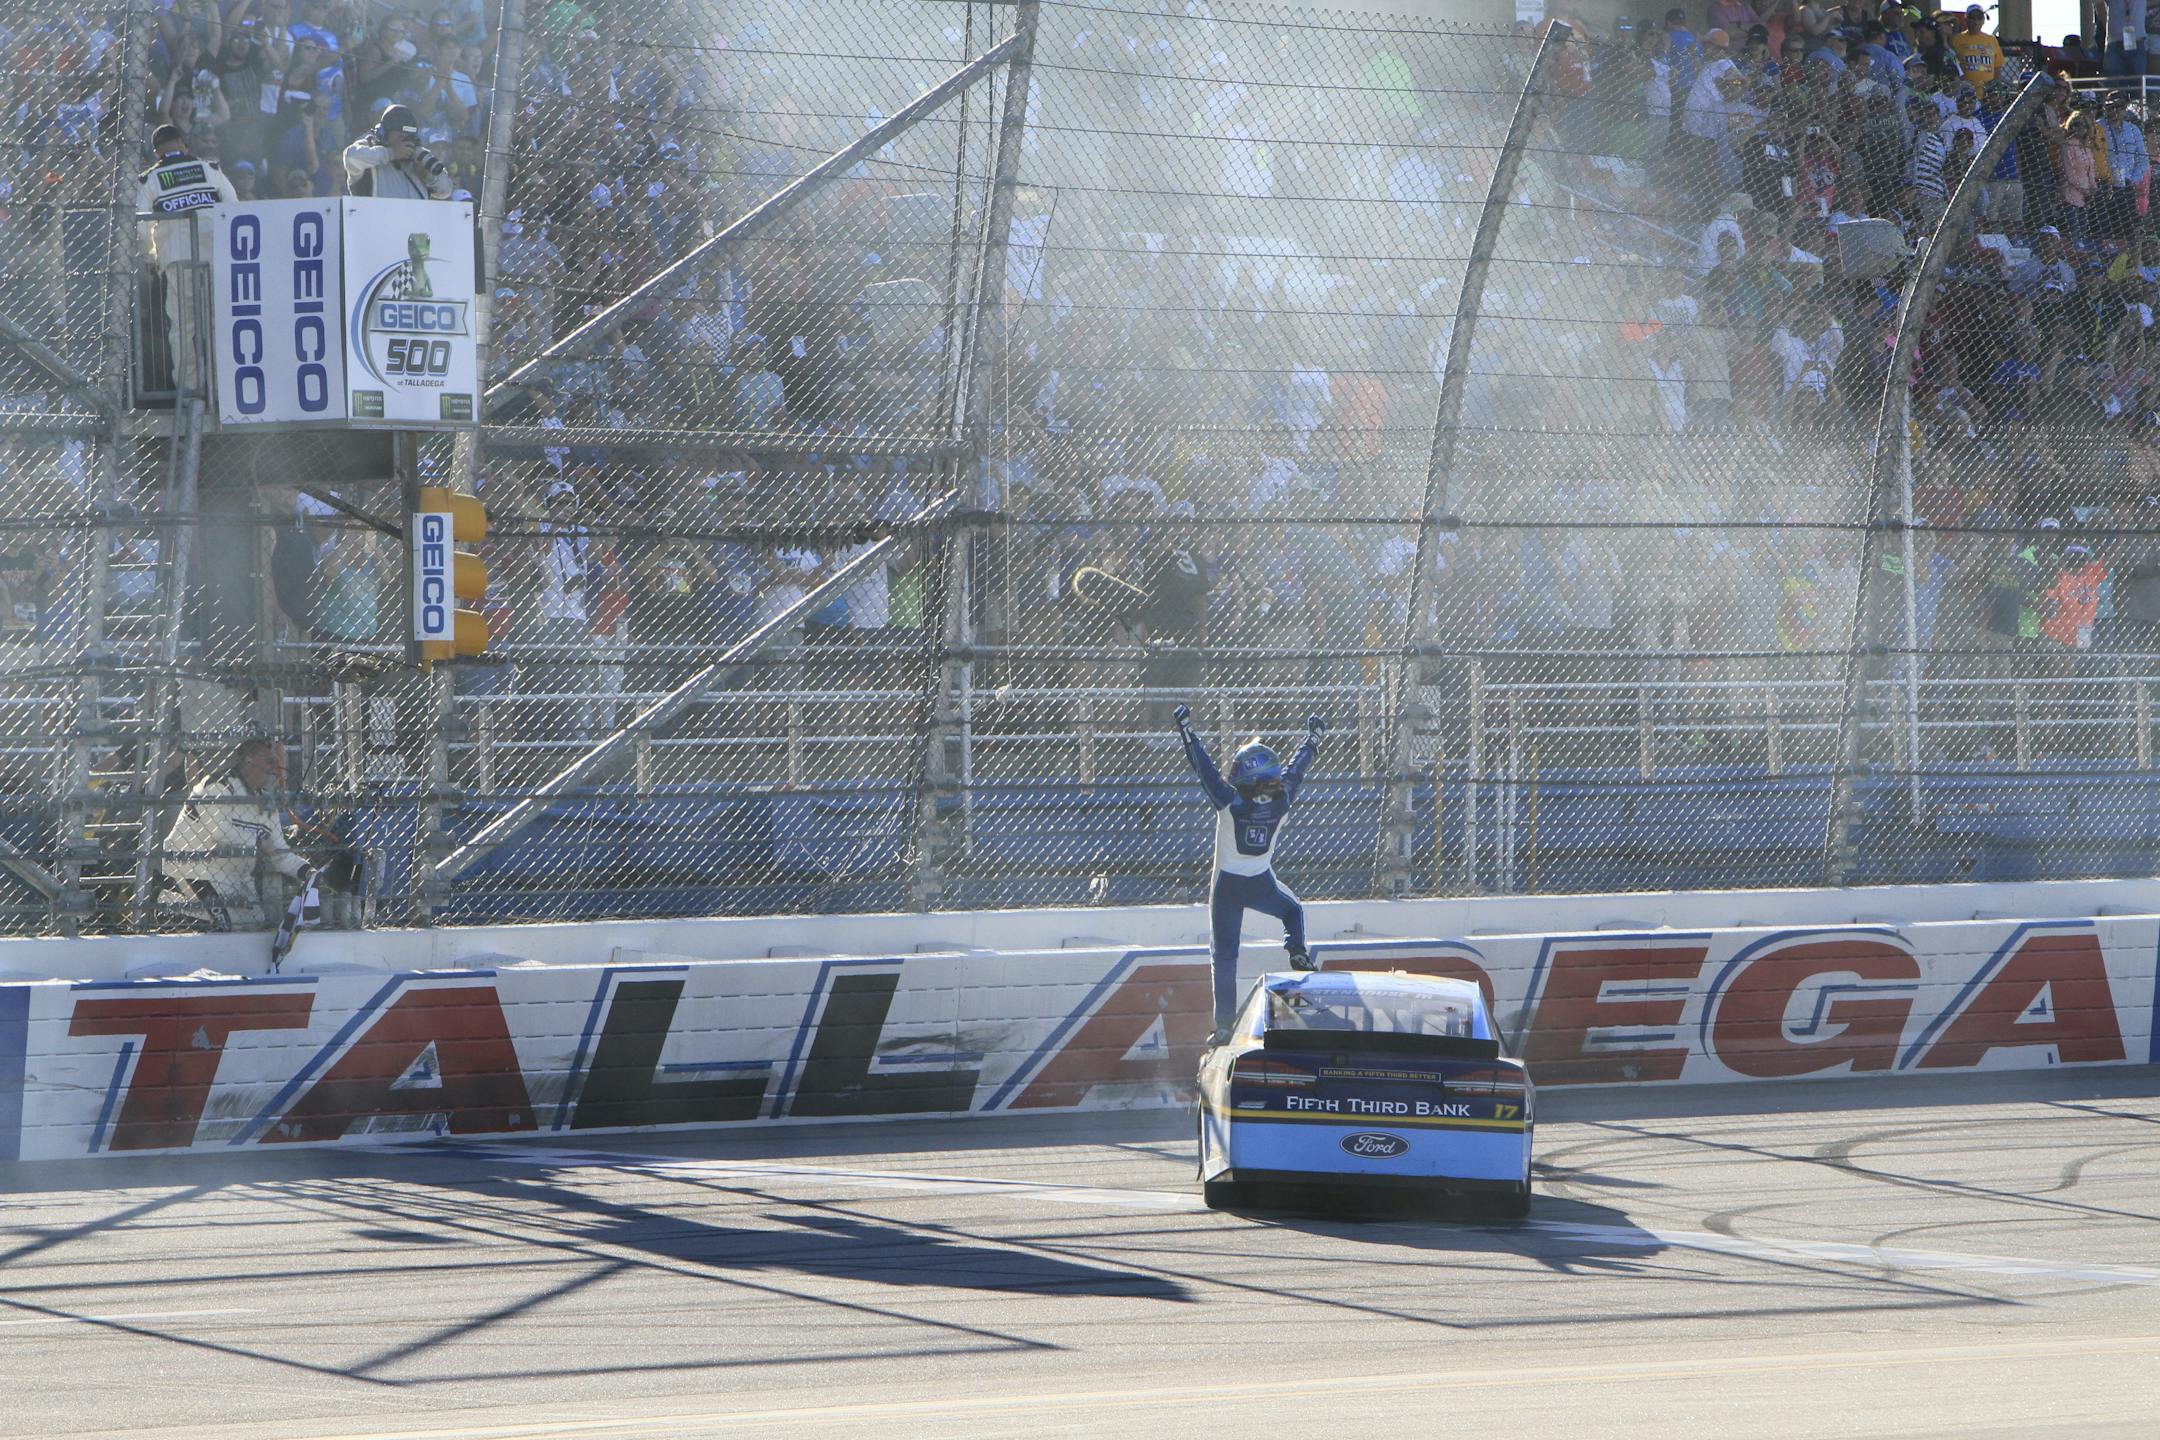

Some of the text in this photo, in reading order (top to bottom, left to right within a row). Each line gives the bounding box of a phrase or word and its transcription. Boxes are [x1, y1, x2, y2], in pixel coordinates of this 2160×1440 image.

[162, 192, 215, 211] OFFICIAL
[230, 214, 266, 414] GEICO
[293, 211, 328, 412] GEICO
[380, 303, 455, 330] GEICO
[385, 338, 452, 377] 500
[404, 379, 445, 387] TALLADEGA
[422, 515, 444, 634] GEICO
[66, 922, 2128, 1152] TALLAEGA
[1387, 1071, 1408, 1079] THIRD
[1409, 1072, 1436, 1080] BETTER
[1286, 1095, 1470, 1117] FIFTH THIRD BANK
[1494, 1103, 1519, 1119] 17
[1354, 1134, 1396, 1154] Ford
